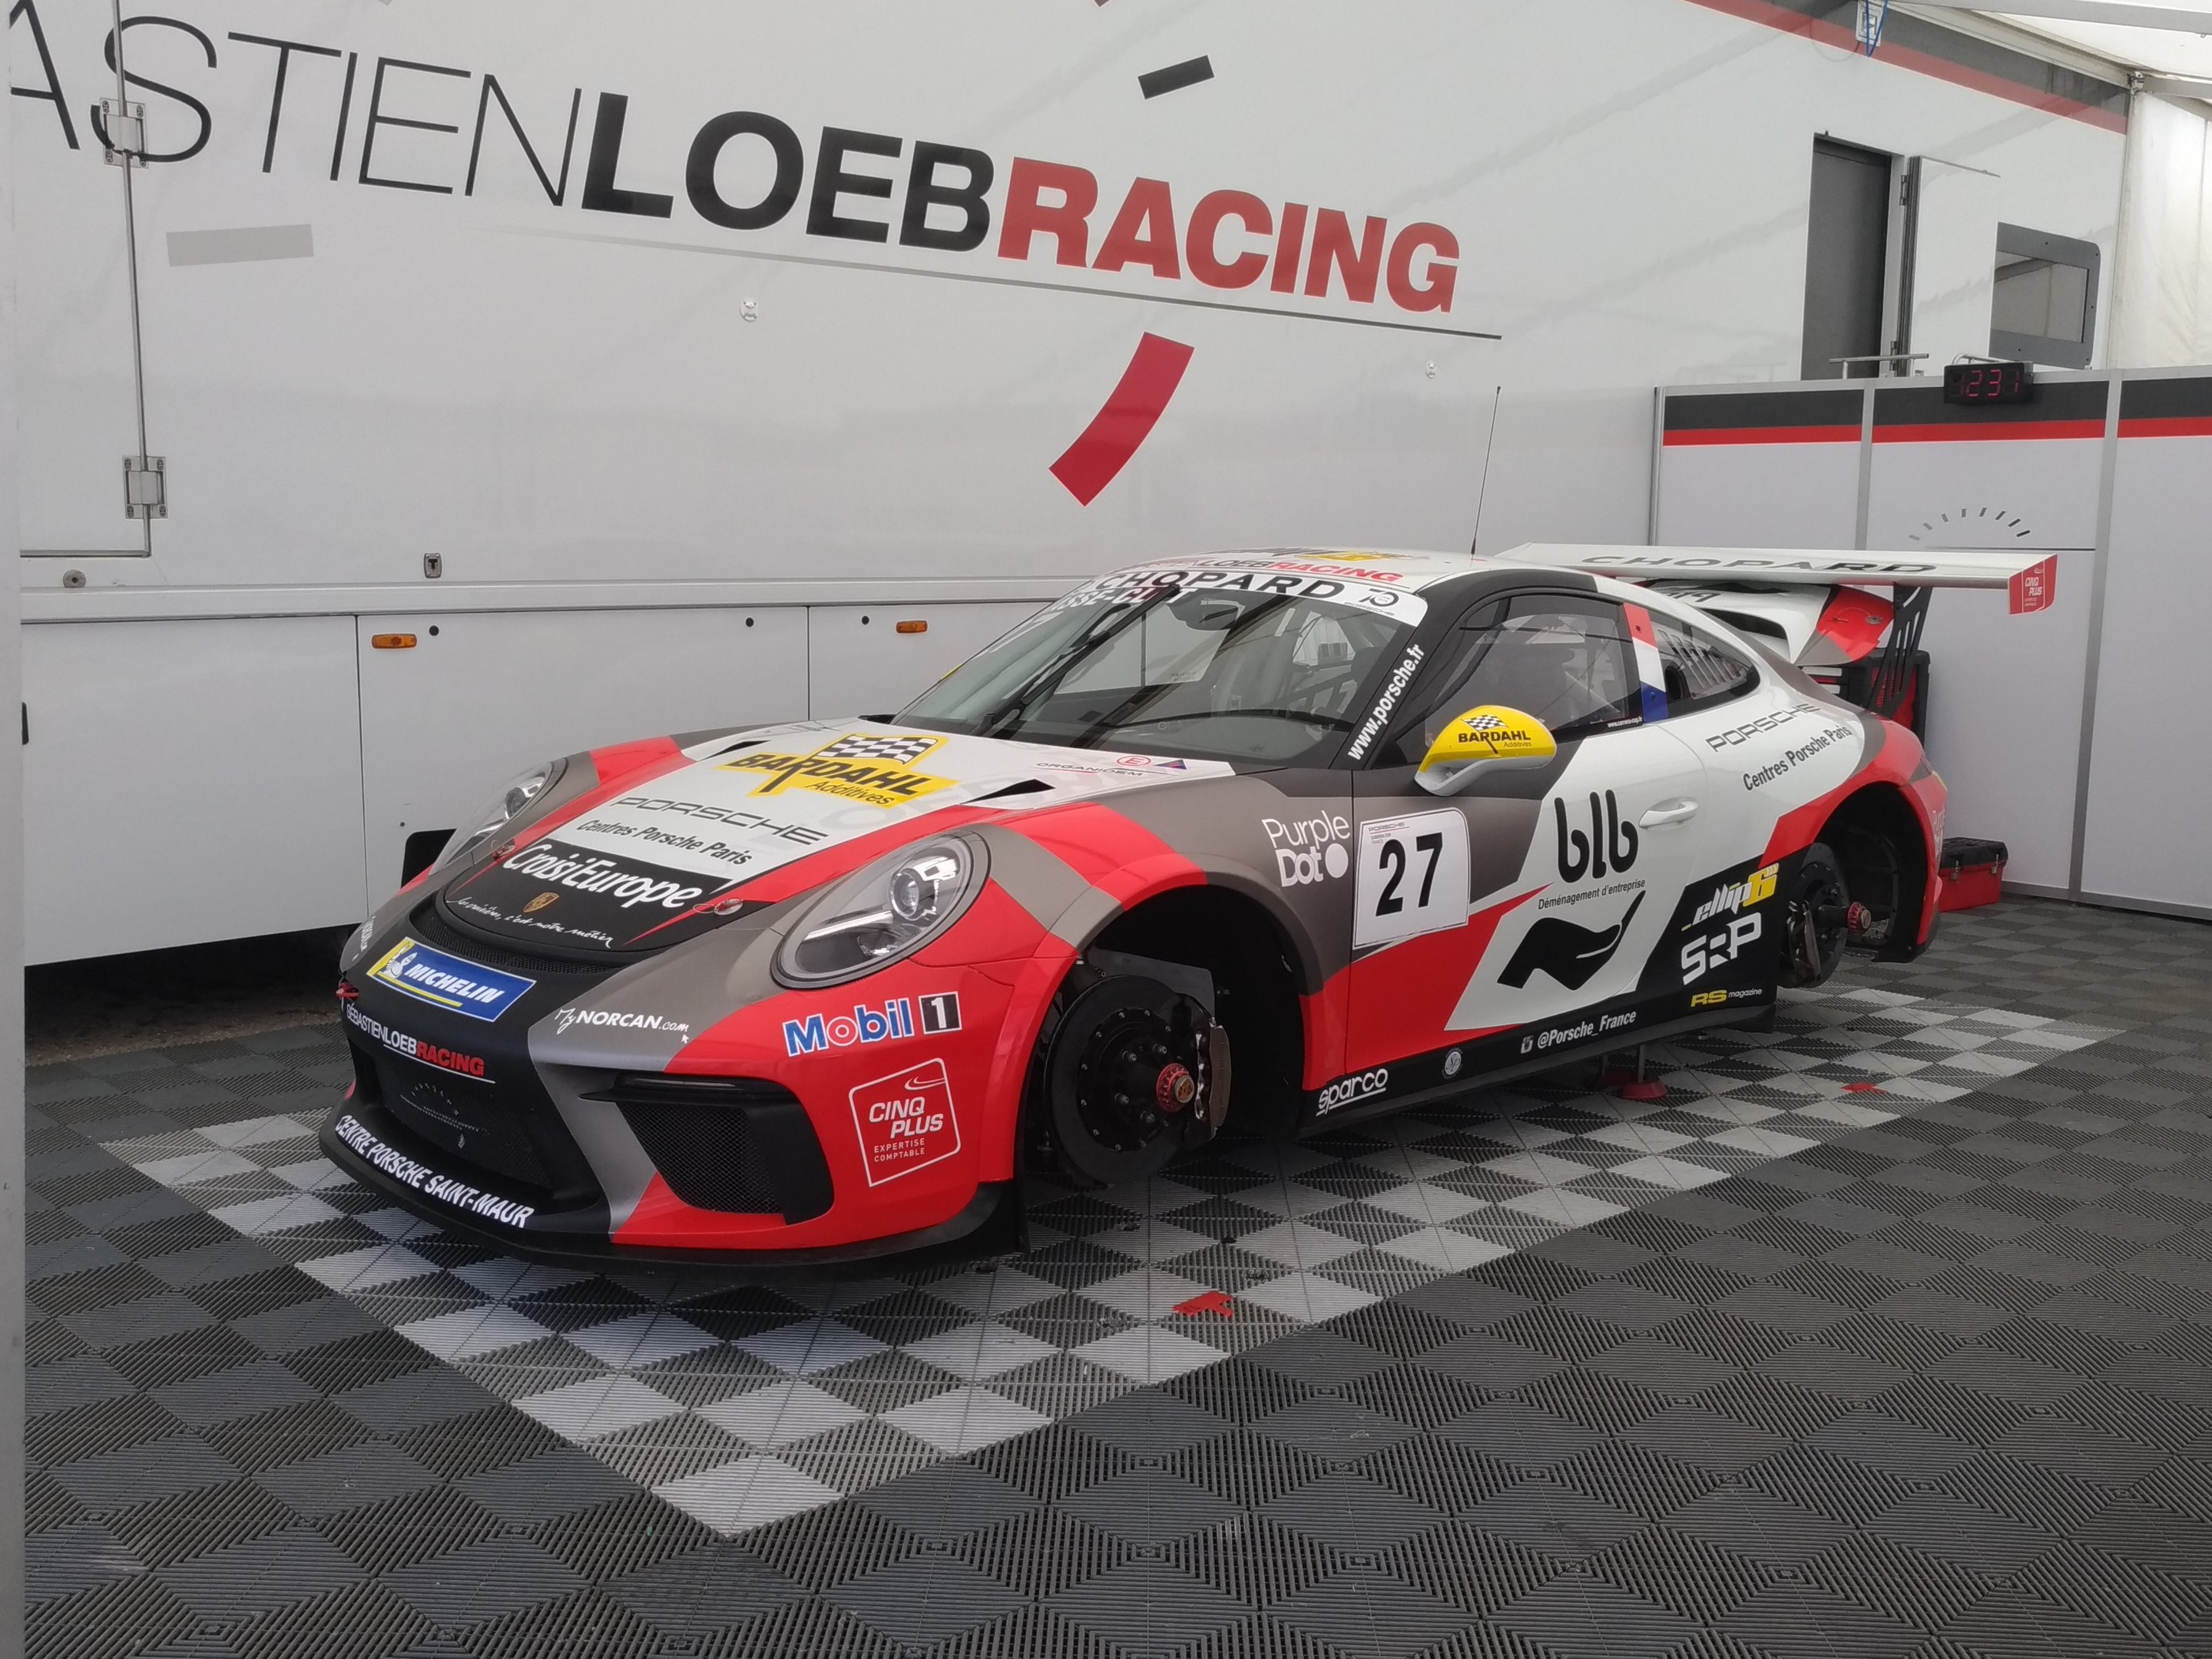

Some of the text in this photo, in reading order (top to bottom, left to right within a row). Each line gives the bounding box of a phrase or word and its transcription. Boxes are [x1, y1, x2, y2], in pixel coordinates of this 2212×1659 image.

[1581, 555, 1939, 573] CHOPARD
[1095, 571, 1346, 599] CHOPARD
[2028, 586, 2043, 597] PLUS
[1347, 644, 1425, 760] www.porsche.fr
[1458, 730, 1532, 745] BARDAHL
[1503, 740, 1532, 749] Additives
[1705, 703, 1821, 753] PORSCHE
[725, 753, 932, 796] BARDAHL
[1037, 761, 1143, 777] ORGANIDEM
[1742, 724, 1853, 791] Centres Porsche Paris
[803, 780, 895, 806] Additives
[609, 796, 830, 846] PORSCHE
[1261, 810, 1351, 849] Purple
[1368, 821, 1406, 832] PORSCHE
[1554, 789, 1639, 883] blb
[576, 819, 753, 866] Centres Porsche Paris
[502, 843, 704, 910] CroisiEurope
[1276, 846, 1324, 887] Dot
[1374, 832, 1444, 917] 27
[1538, 879, 1646, 910] Déménagement d'entreprise
[404, 961, 506, 1004] MICHELIN
[1690, 988, 1763, 1008] RS magazine
[782, 997, 915, 1057] Mobil
[1537, 1011, 1637, 1049] @Porsche_France
[869, 1096, 926, 1123] CINQ
[1316, 1068, 1389, 1116] sparco
[873, 1137, 926, 1154] EXPERTISE
[889, 1114, 945, 1139] PLUS
[335, 1115, 535, 1228] CENTRE PORSCHE SAINT-MAUR
[873, 1147, 926, 1163] COMPTABLE
